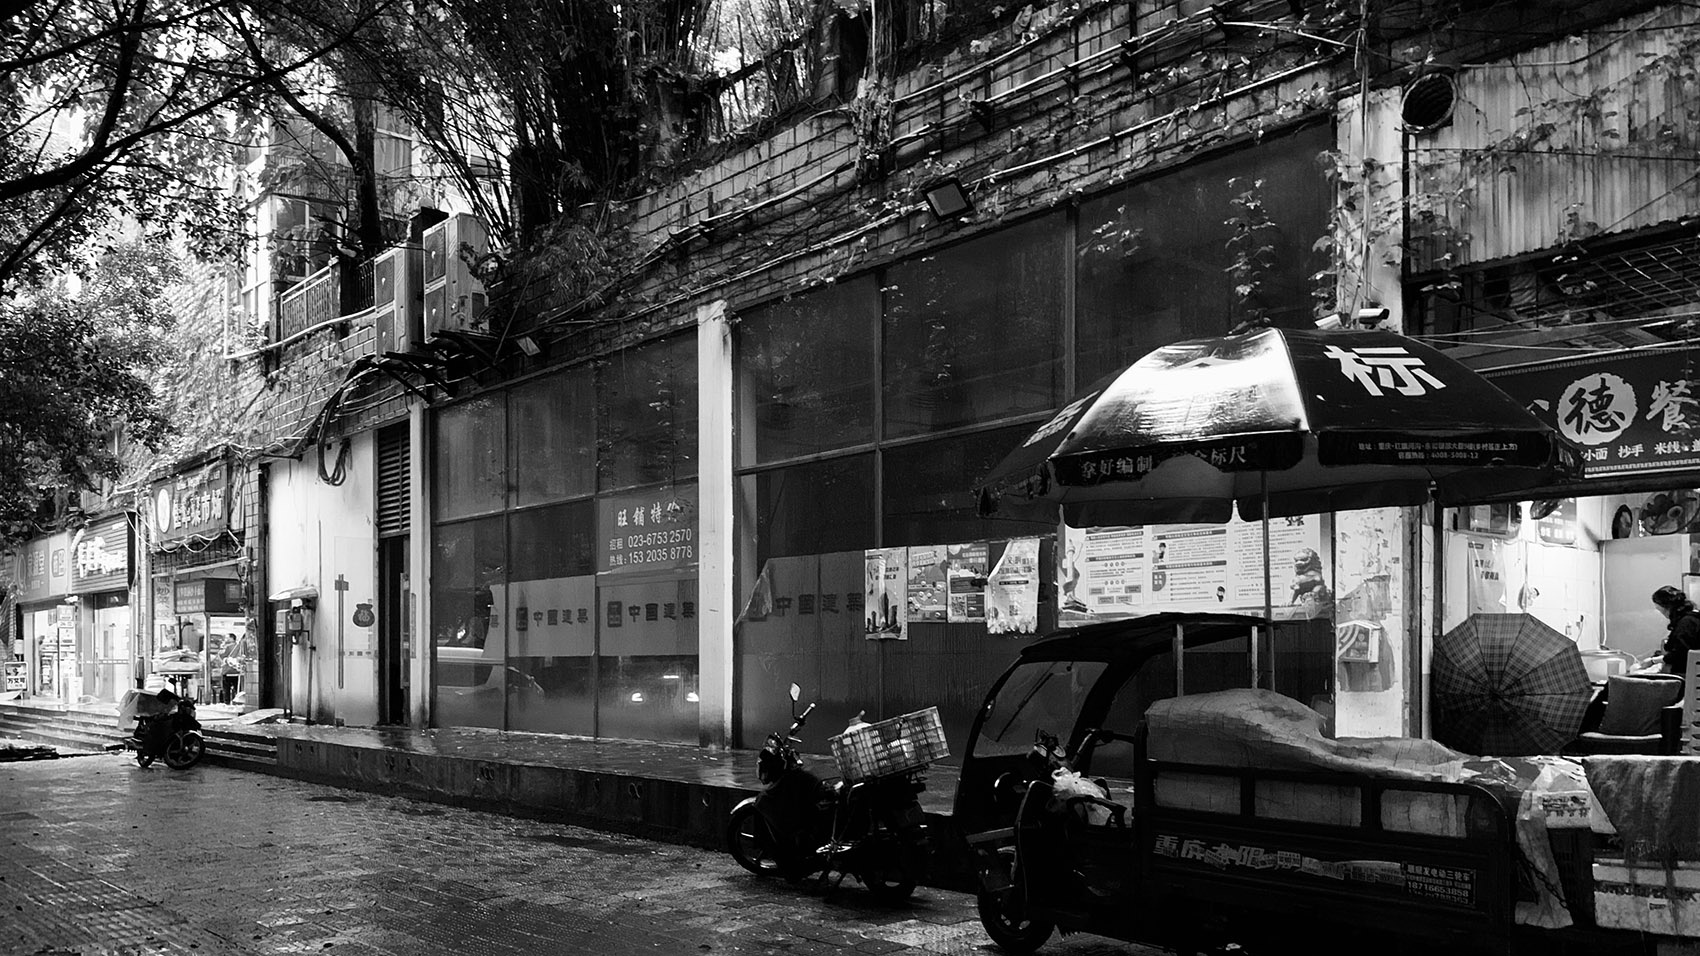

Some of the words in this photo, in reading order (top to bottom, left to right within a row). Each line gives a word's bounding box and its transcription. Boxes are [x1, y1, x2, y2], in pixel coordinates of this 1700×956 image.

[1323, 345, 1445, 397] 标
[1618, 444, 1644, 459] 抄手
[628, 531, 668, 549] 023-6753
[669, 528, 692, 544] 2570
[629, 550, 644, 564] 153
[646, 548, 668, 563] 2035
[670, 545, 693, 560] 8778
